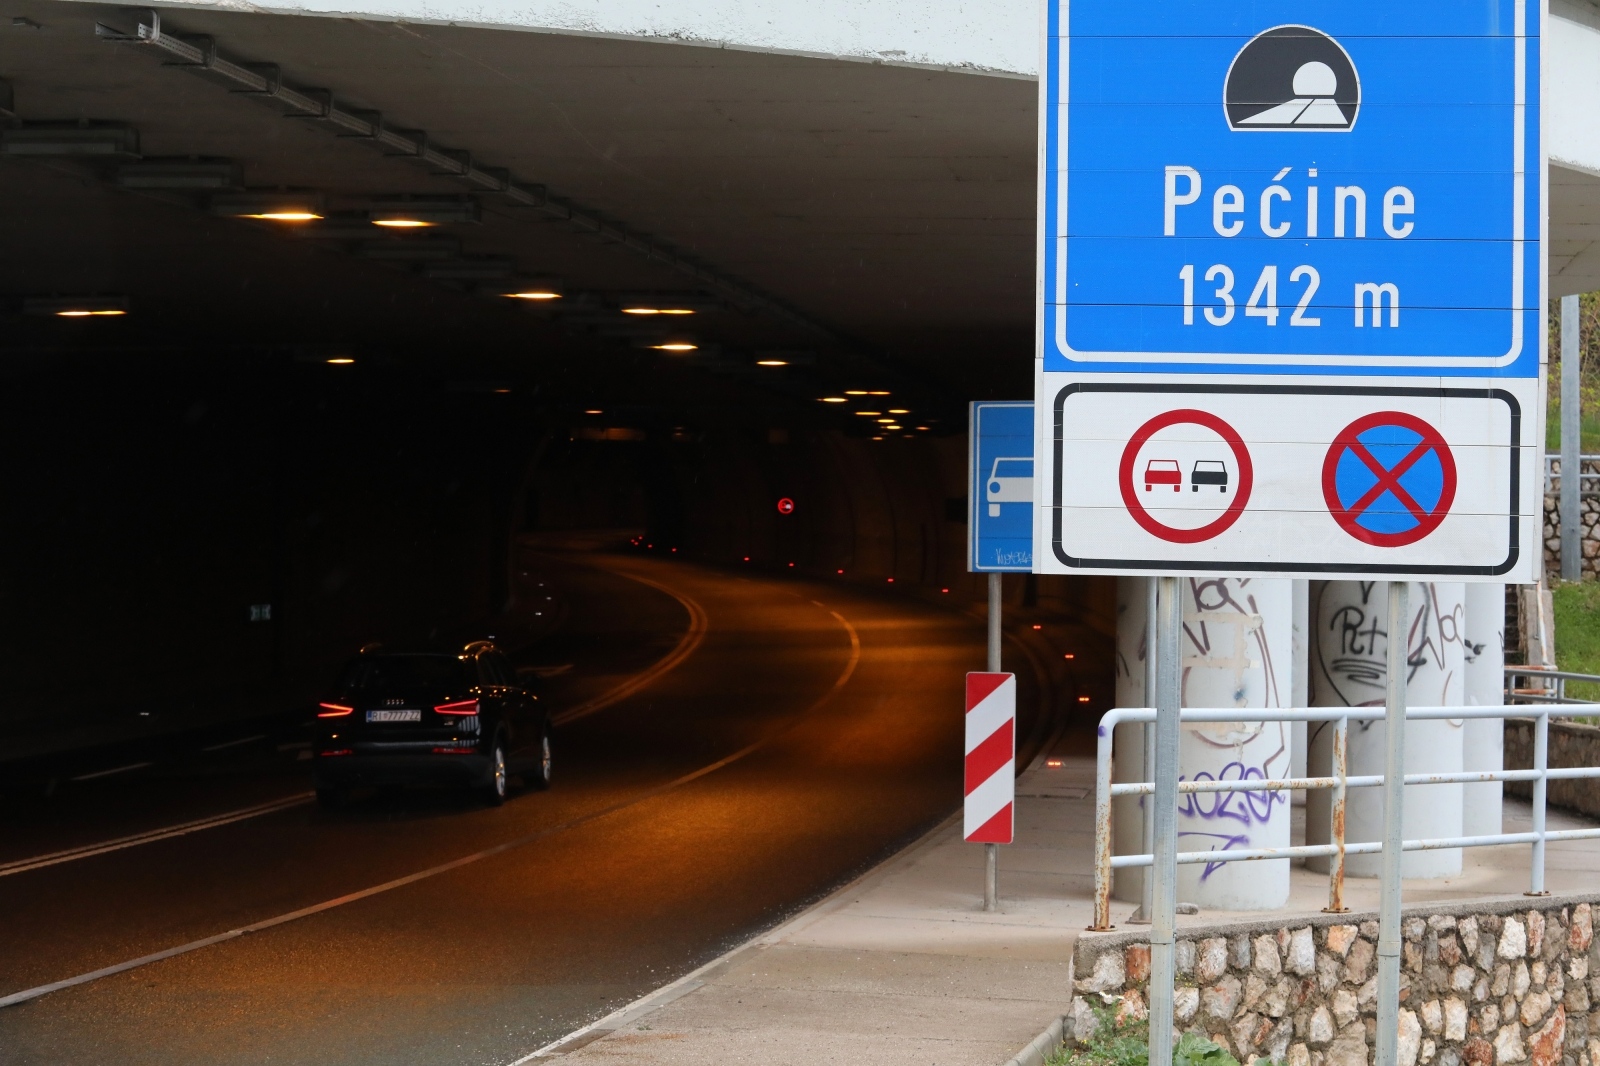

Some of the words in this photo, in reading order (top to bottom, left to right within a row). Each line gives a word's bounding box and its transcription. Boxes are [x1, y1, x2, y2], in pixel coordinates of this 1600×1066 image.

[1163, 165, 1416, 239] Pećine
[1178, 264, 1321, 328] 1342
[1354, 281, 1400, 328] m
